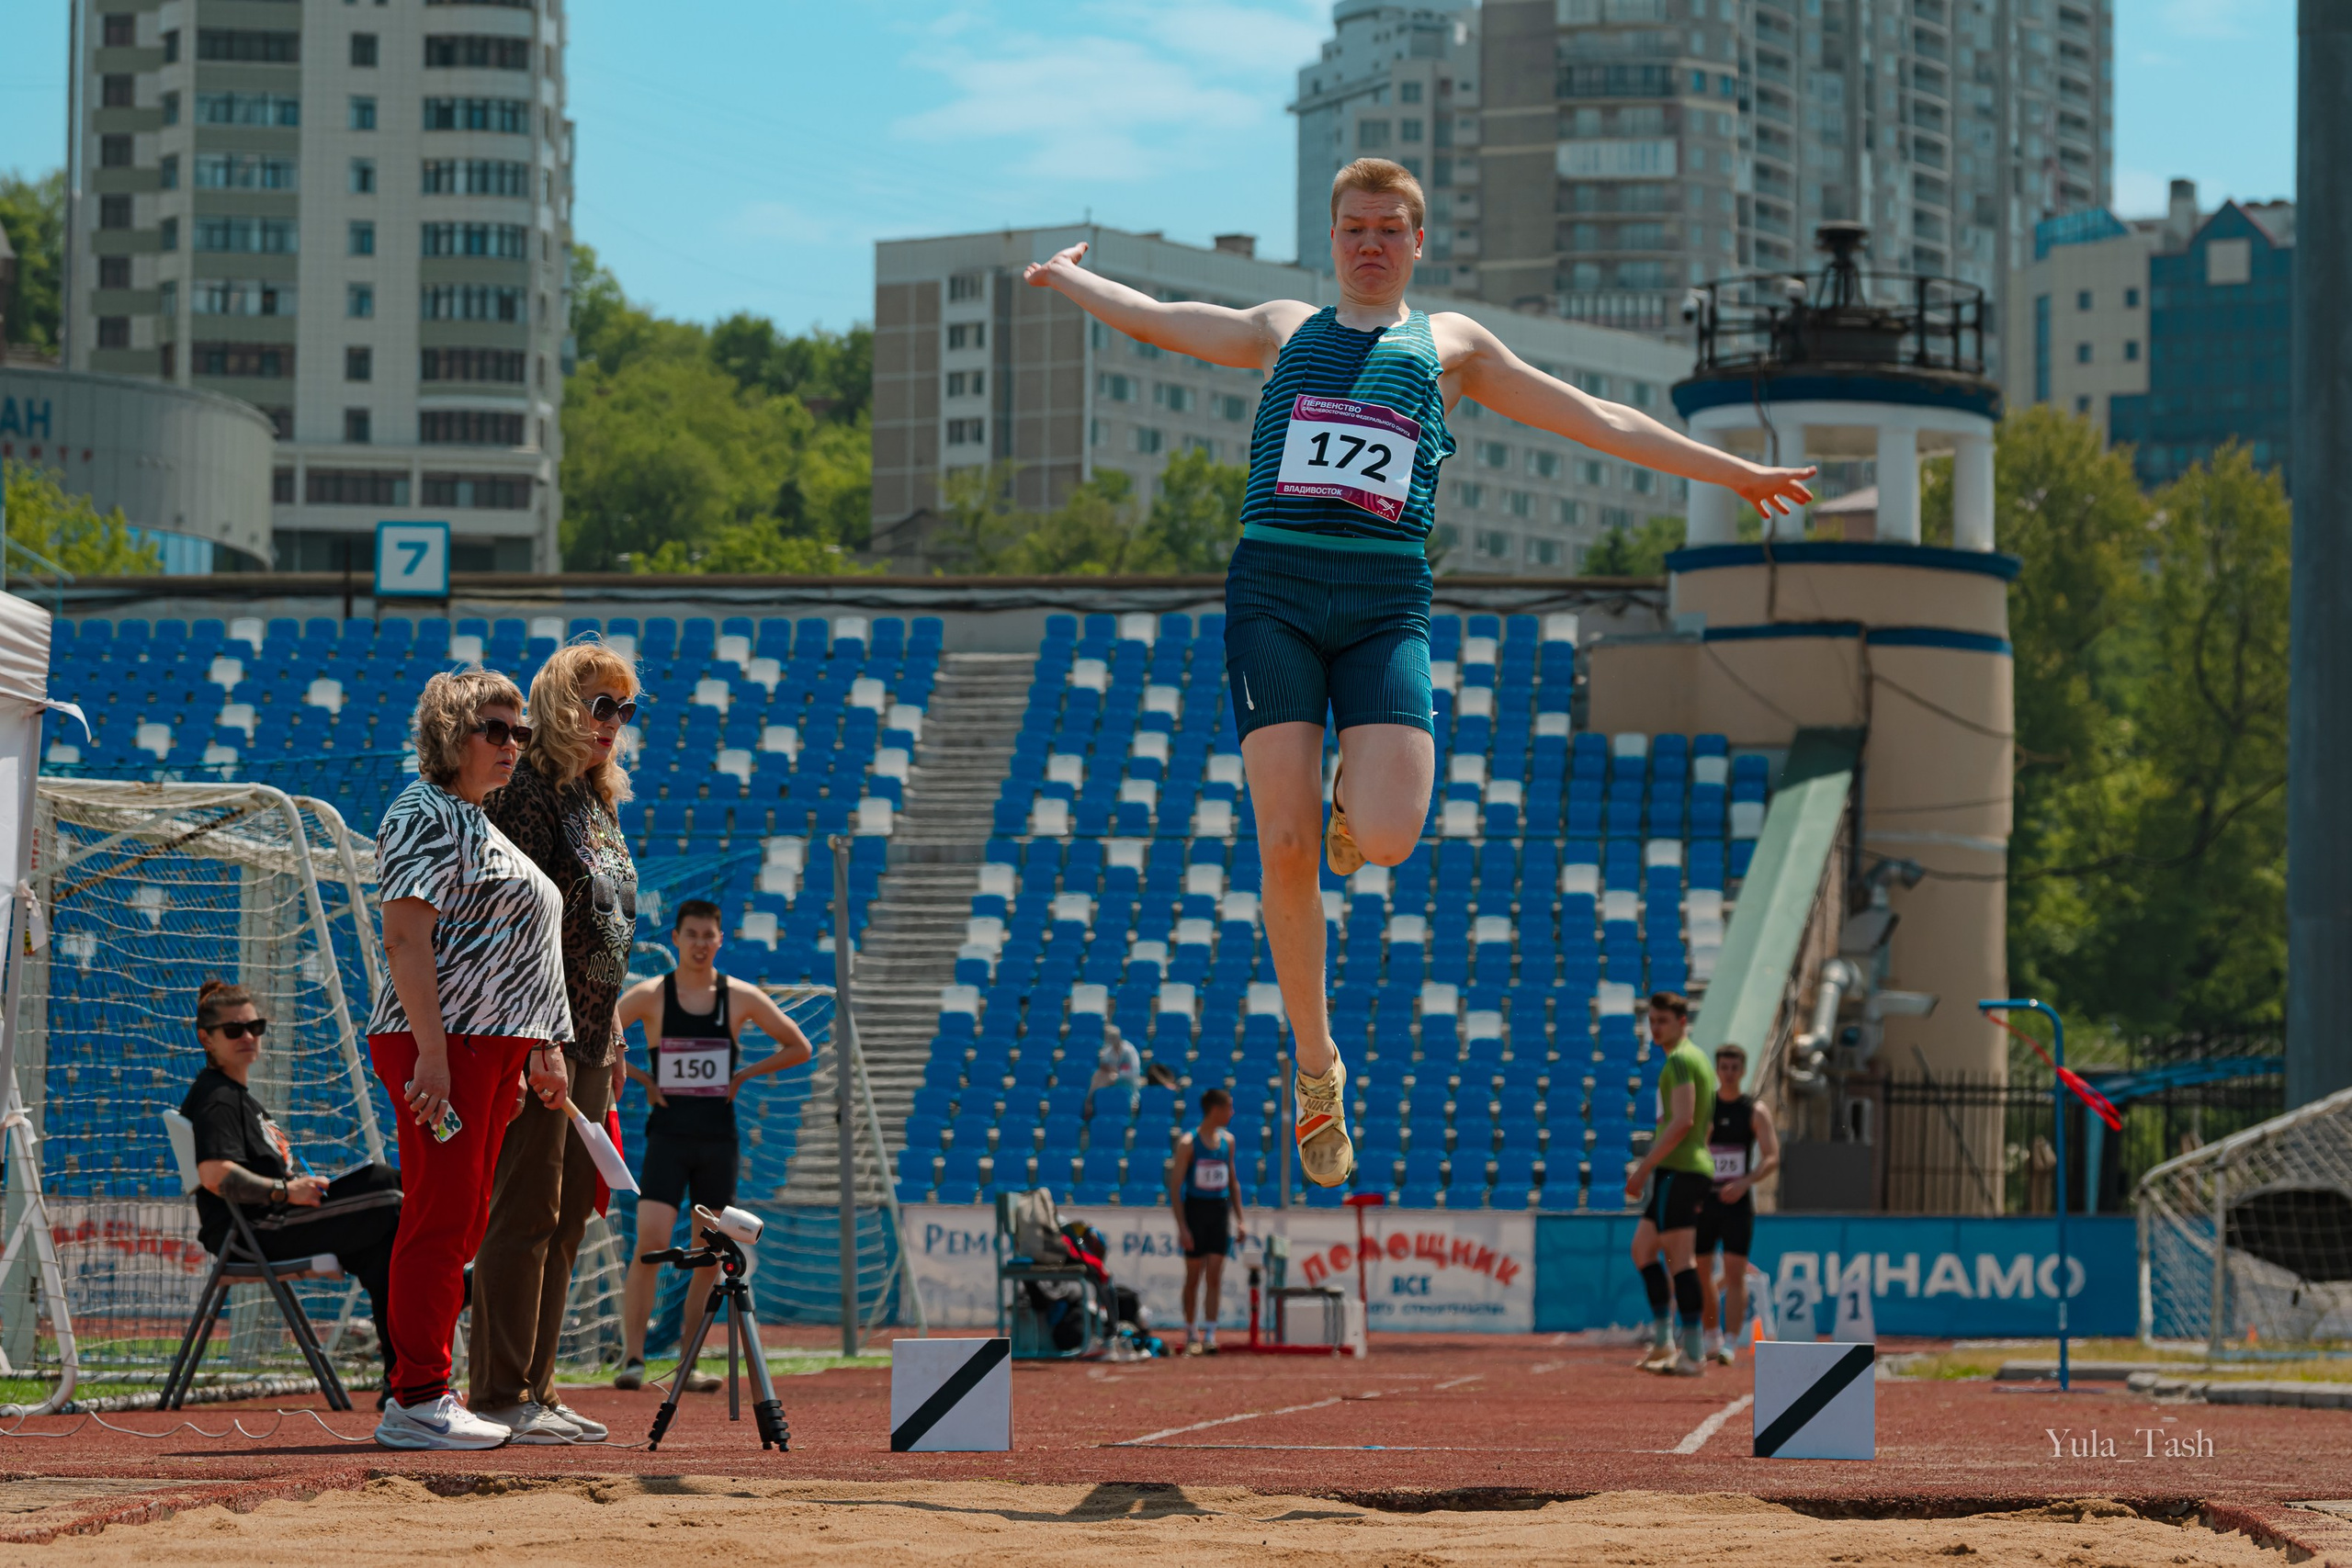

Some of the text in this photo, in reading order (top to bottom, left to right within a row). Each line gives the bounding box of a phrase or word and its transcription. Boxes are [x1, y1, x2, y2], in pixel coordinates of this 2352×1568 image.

[1301, 406, 1411, 437] ДАЛЬНЕВОСТОЧНОГО ФЕДЕРАЛЬНОГО ОКРУГА
[1303, 399, 1362, 413] ПЕРВЕНСТВО
[1307, 431, 1392, 483] 172
[1283, 484, 1343, 496] ВЛАДИВОСТОК
[396, 540, 429, 576] 7
[673, 1058, 717, 1079] 150
[1304, 1098, 1335, 1112] NIKE
[1774, 1251, 2086, 1304] ДИНАМО
[1785, 1289, 1806, 1321] 2
[1846, 1290, 1862, 1321] 1
